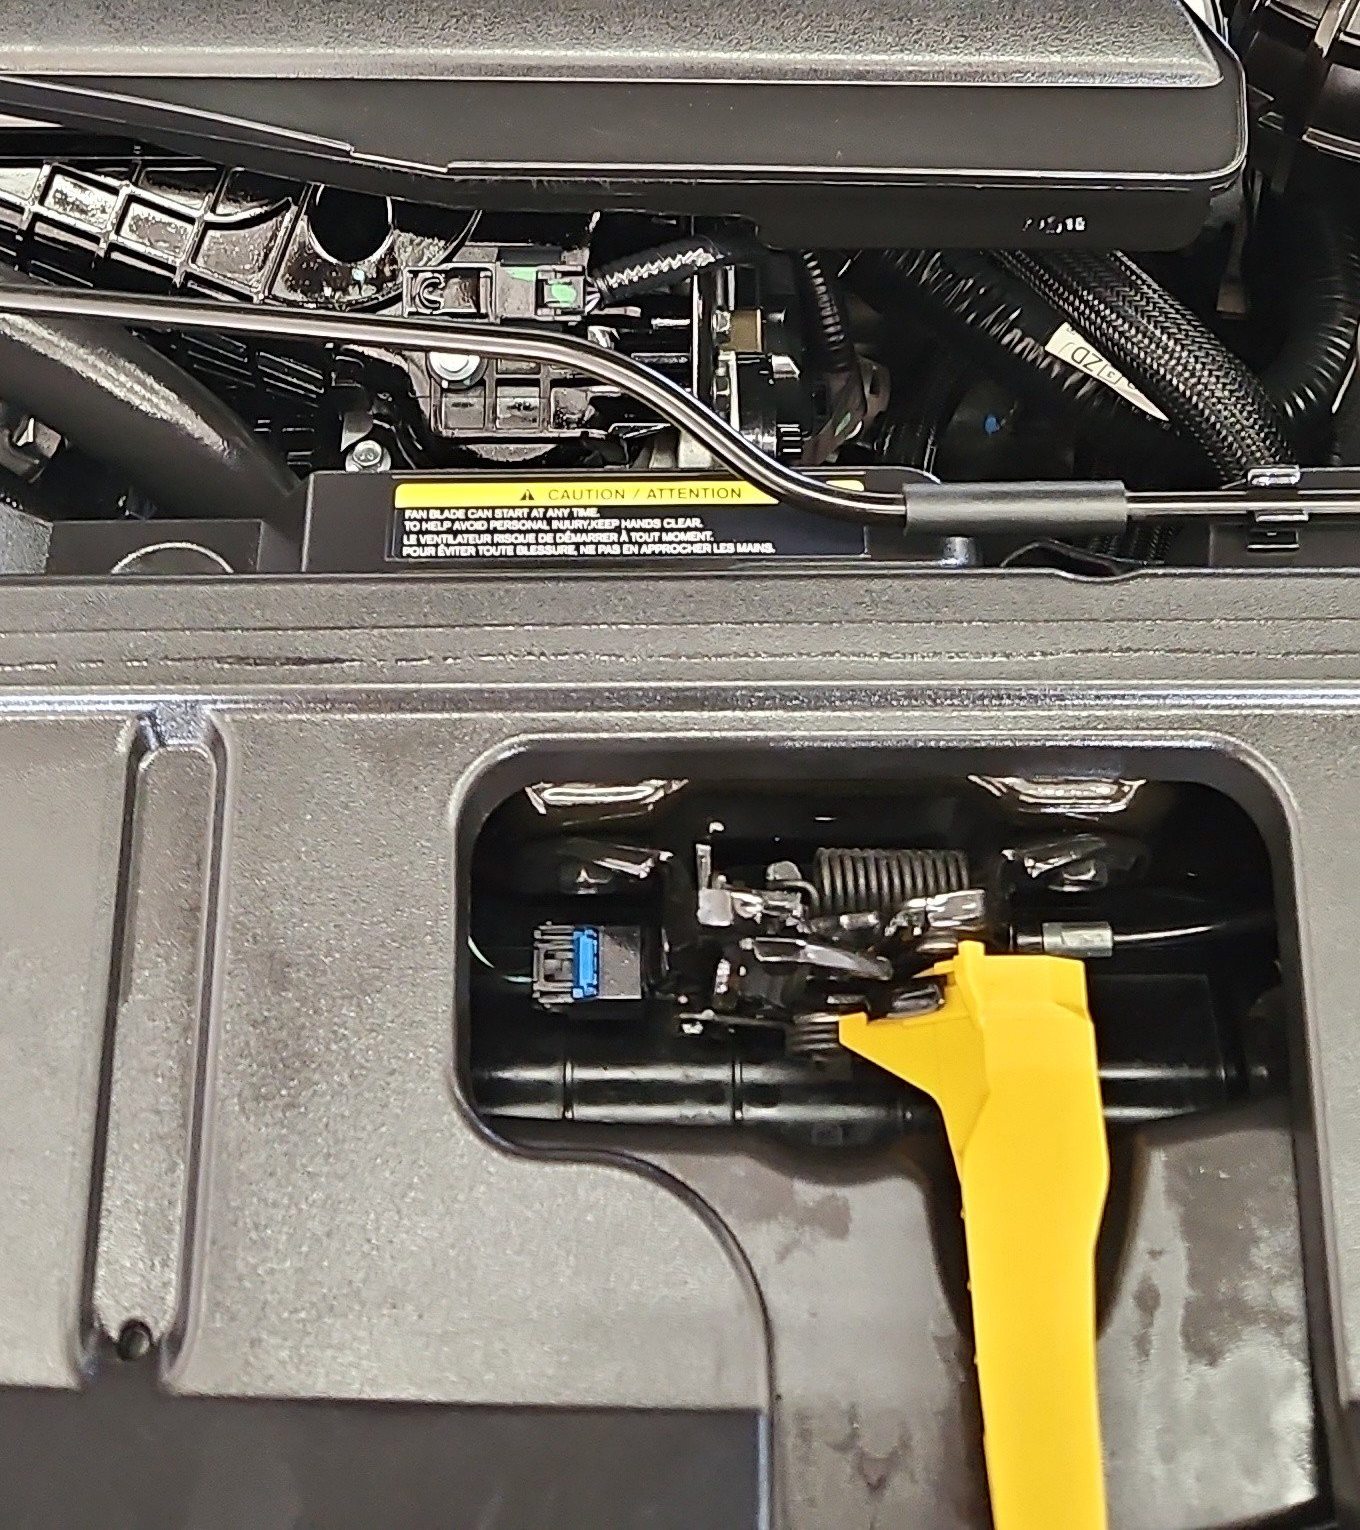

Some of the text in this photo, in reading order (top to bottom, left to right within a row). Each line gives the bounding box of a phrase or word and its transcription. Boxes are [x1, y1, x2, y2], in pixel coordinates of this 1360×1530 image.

[547, 487, 742, 501] CAUTION / ATTENTION
[404, 507, 601, 519] FAN BLADE CAN START AT ANY TIME.
[403, 521, 420, 531] TO
[421, 520, 452, 531] HELP
[452, 520, 488, 531] AVOID
[489, 520, 550, 530] PERSONAL
[621, 519, 662, 529] HANDS
[663, 518, 704, 528] CLEAR.
[402, 534, 417, 544] LE
[418, 533, 492, 544] VENTILATEUR
[493, 533, 537, 544] RISQUE
[537, 533, 554, 543] DE
[555, 531, 618, 543] DÉMARRER
[630, 531, 661, 542] TOUT
[661, 531, 715, 542] MOMENT.
[402, 546, 436, 557] POUR
[439, 544, 476, 556] ÉVITER
[478, 546, 515, 556] TOUTE
[579, 545, 597, 555] NE
[598, 544, 621, 555] PAS
[622, 544, 639, 554] EN
[640, 543, 712, 554] APPROCHER
[713, 543, 736, 554] LES
[736, 542, 776, 553] MAINS.
